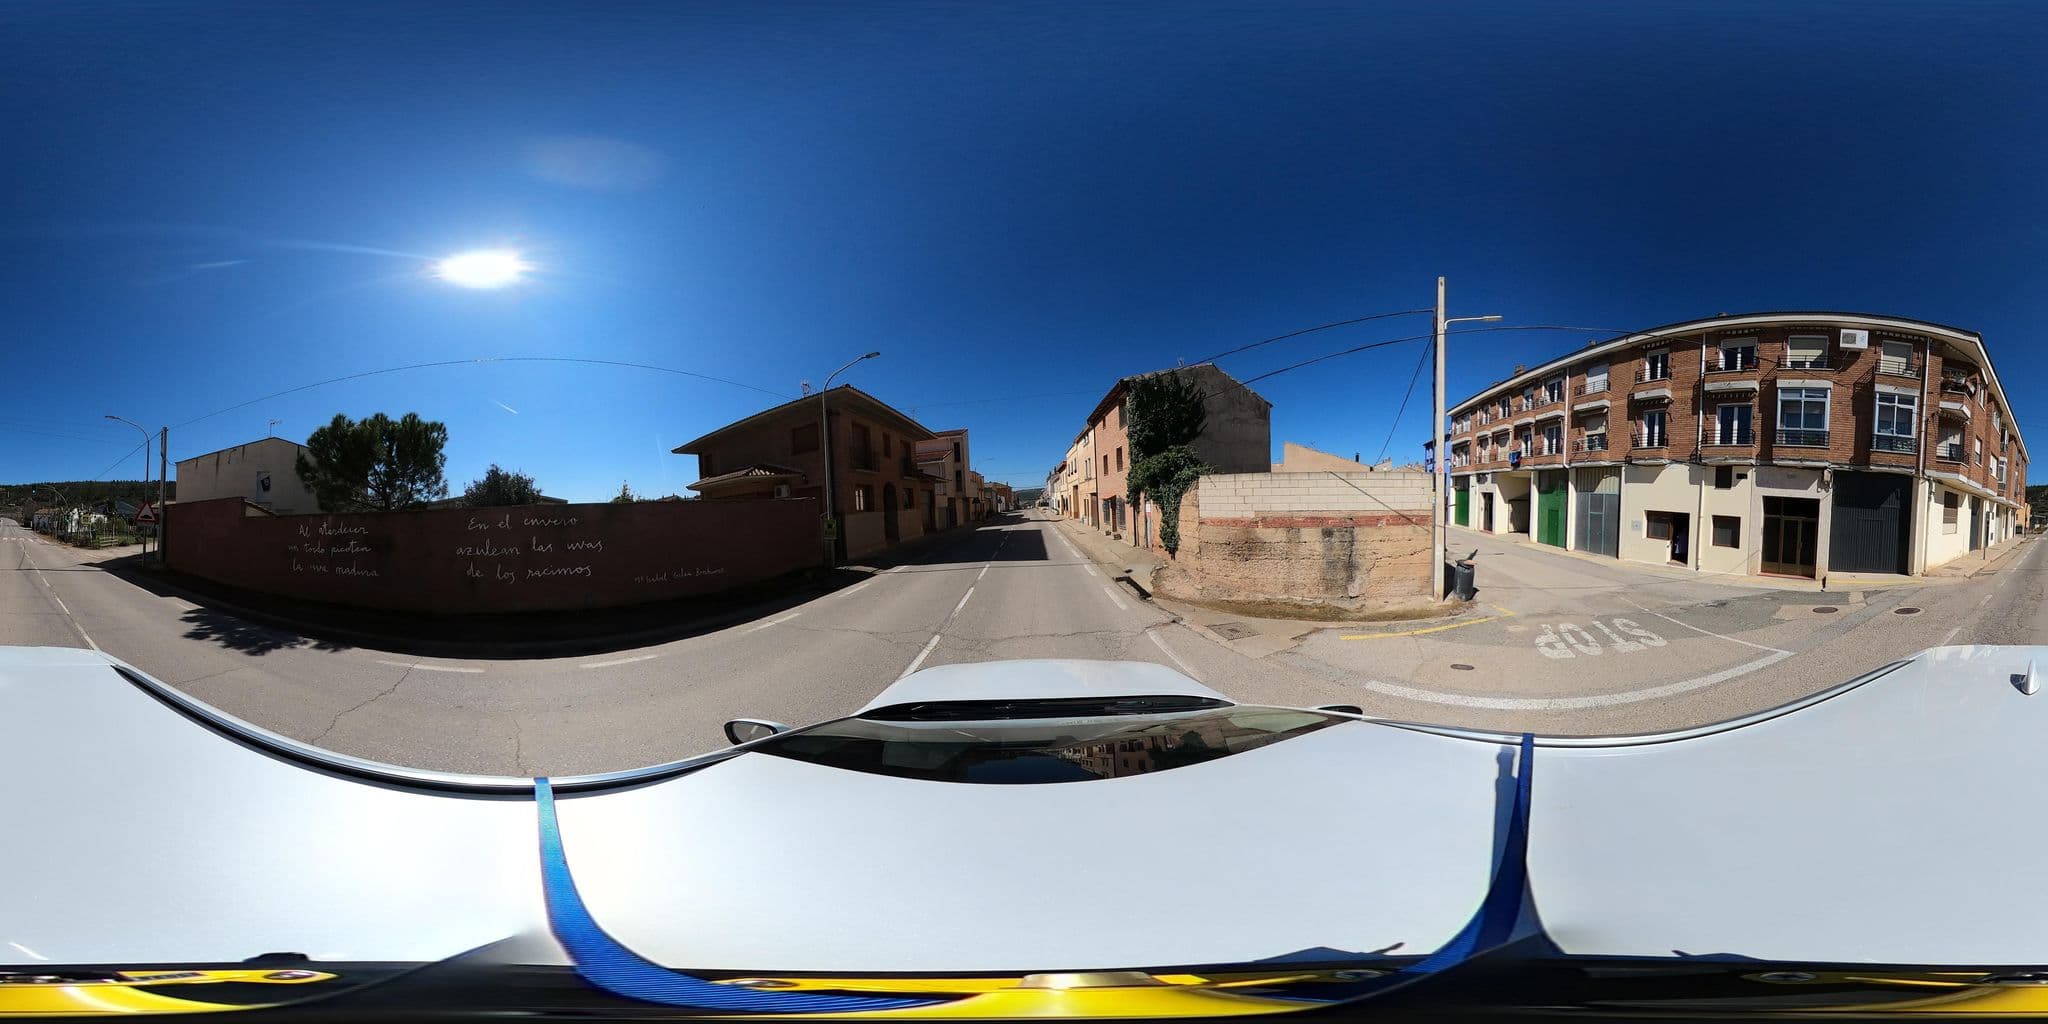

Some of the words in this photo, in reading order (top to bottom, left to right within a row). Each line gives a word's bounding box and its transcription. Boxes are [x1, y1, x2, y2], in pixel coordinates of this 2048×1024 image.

[467, 517, 490, 530] En
[497, 514, 512, 530] el
[532, 536, 553, 552] las
[466, 561, 484, 578] de
[496, 563, 515, 584] los
[526, 564, 592, 579] racimos
[1535, 618, 1668, 659] STOP
